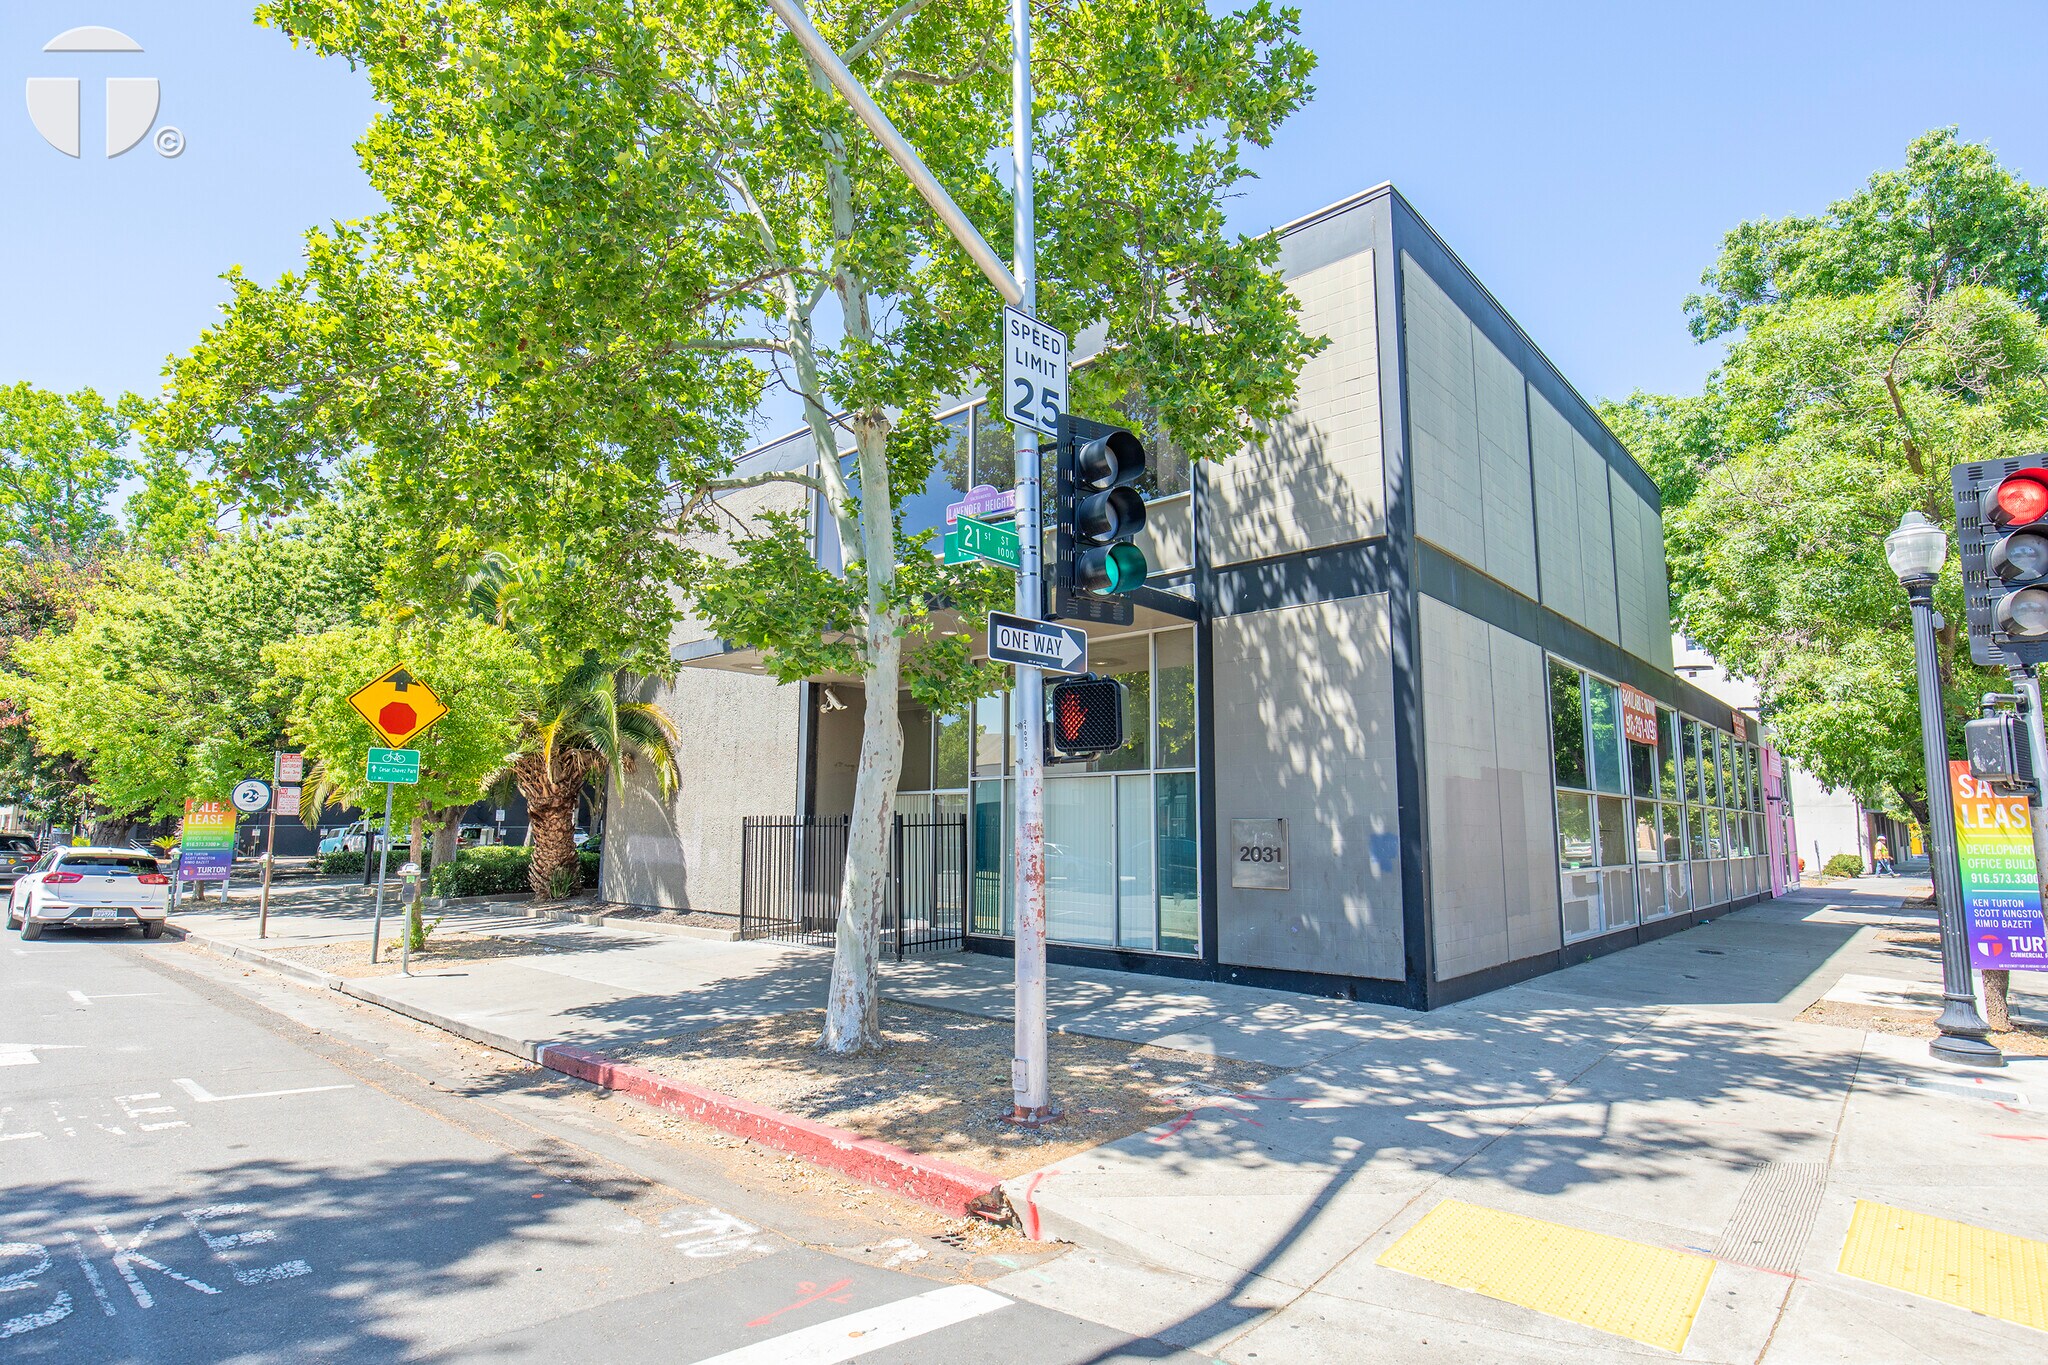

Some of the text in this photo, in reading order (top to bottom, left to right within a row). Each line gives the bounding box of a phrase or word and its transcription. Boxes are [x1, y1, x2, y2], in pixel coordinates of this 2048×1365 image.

[1011, 319, 1061, 355] SPEED
[1015, 347, 1057, 379] LIMIT
[1013, 377, 1061, 429] 25
[949, 494, 1015, 519] LAVENDER HEIGHTS
[964, 524, 980, 550] 21
[1001, 536, 1009, 546] ST
[997, 546, 1015, 560] 1000
[1001, 628, 1062, 656] ONE WAY
[1958, 773, 2023, 799] SA
[188, 813, 224, 825] LEASE
[1240, 846, 1281, 863] 2031
[1967, 858, 2003, 870] OFFICE
[1970, 872, 2039, 884] 916.573.3300
[1972, 898, 2025, 908] KEN TURTON
[1973, 908, 2044, 919] SCOTT KINGSTON
[1975, 919, 2033, 929] KIMIO BAZETT
[2010, 951, 2044, 959] COMMERCIAL
